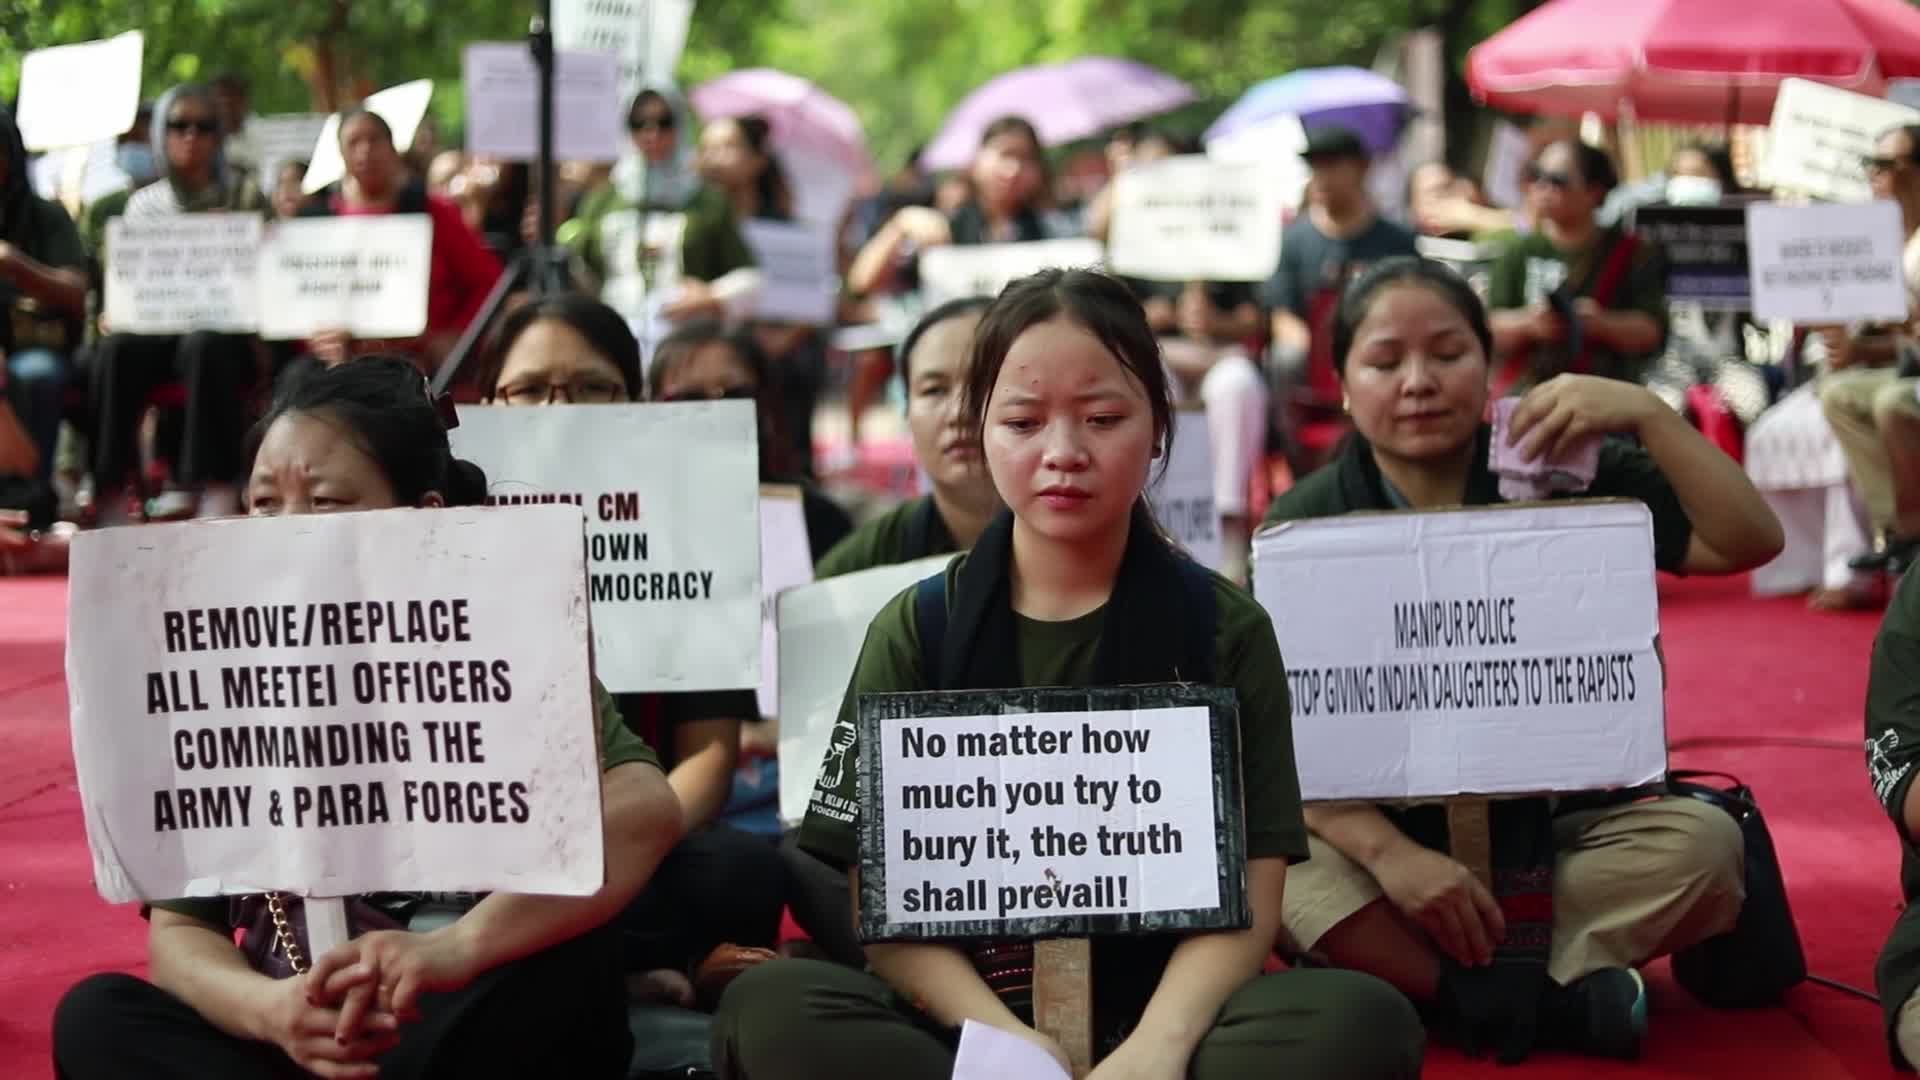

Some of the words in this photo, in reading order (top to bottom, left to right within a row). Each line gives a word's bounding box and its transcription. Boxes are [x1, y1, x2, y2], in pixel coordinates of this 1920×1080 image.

[597, 492, 639, 522] CM
[589, 532, 648, 563] OWN
[590, 571, 713, 603] MOCRACY
[163, 599, 471, 653] REMOVE/REPLACE
[1393, 599, 1465, 649] MANIPUR
[1466, 596, 1517, 647] POLICE
[146, 669, 209, 715] ALL
[221, 663, 338, 709] MEETEI
[352, 659, 512, 705] OFFICERS
[1324, 665, 1376, 716] GIVING
[1377, 663, 1430, 713] INDIAN
[1431, 658, 1520, 710] DAUGHTERS
[1520, 657, 1543, 707] TO
[1543, 655, 1574, 705] THE
[1576, 652, 1636, 704] RAPISTS
[174, 721, 411, 771] COMMANDING
[422, 721, 485, 764] THE
[901, 727, 946, 758] No
[957, 725, 1073, 757] matter
[1082, 723, 1150, 754] how
[153, 785, 252, 833] ARMY
[269, 789, 284, 827] &
[293, 781, 390, 828] PARA
[403, 780, 530, 824] FORCES
[902, 776, 997, 810] much
[1005, 781, 1064, 815] you
[1073, 774, 1119, 812] try
[1127, 773, 1162, 804] to
[903, 829, 977, 868] bury
[986, 827, 1020, 865] it,
[1030, 825, 1087, 857] the
[1096, 822, 1182, 857] truth
[903, 879, 987, 913] shall
[998, 876, 1128, 918] prevail!
